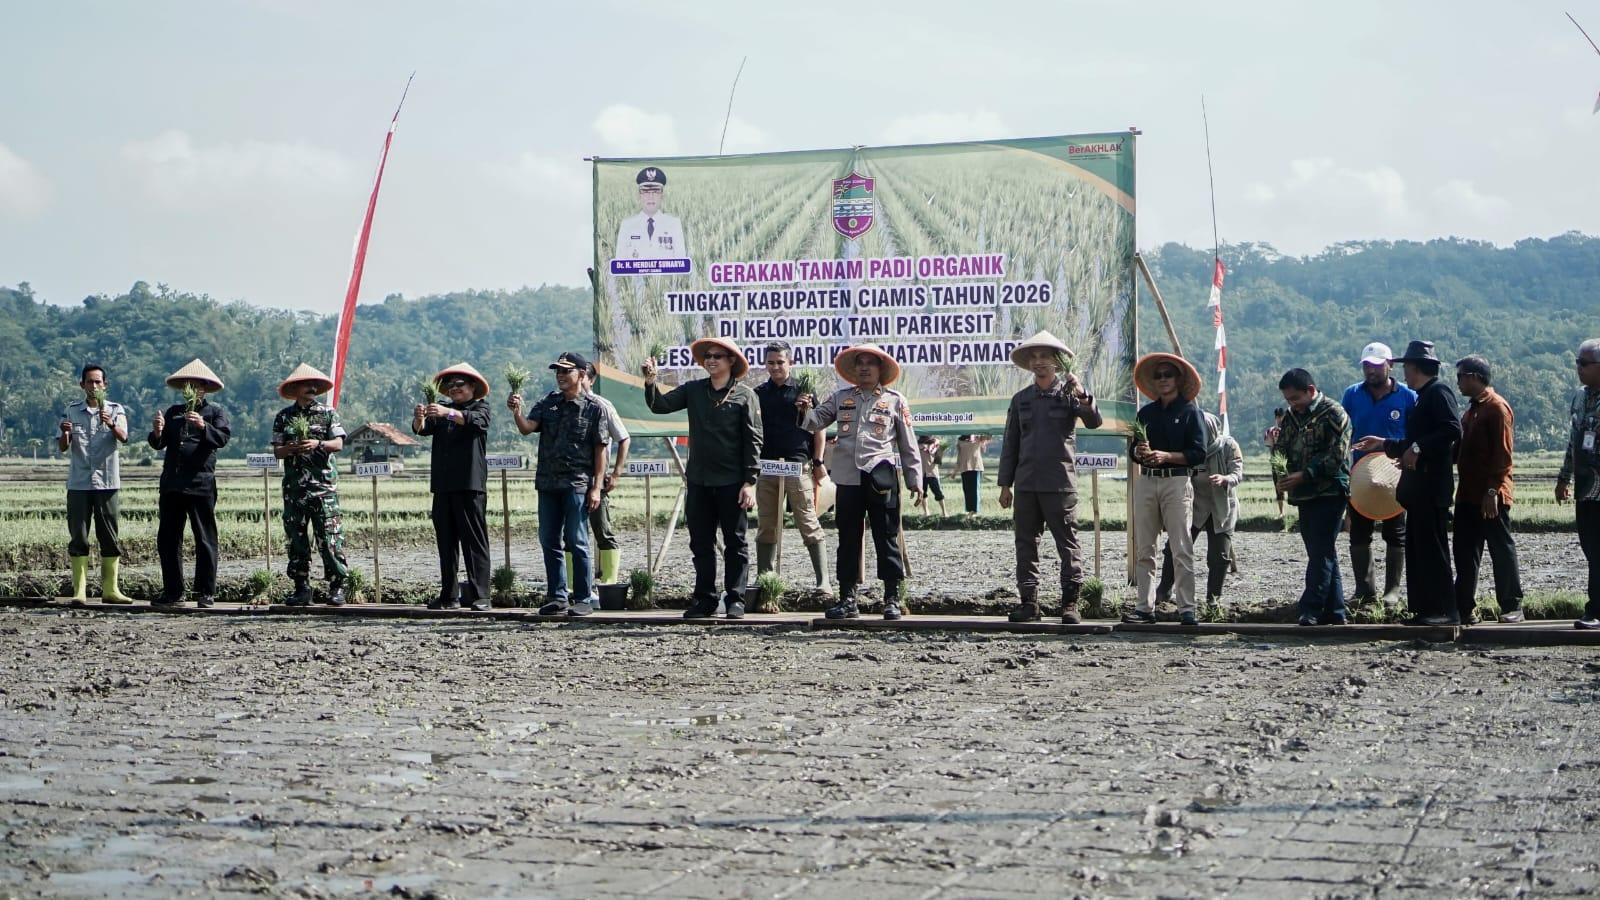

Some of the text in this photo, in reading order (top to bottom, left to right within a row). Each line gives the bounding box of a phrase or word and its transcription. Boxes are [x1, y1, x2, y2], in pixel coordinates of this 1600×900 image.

[711, 255, 1004, 283] GERAKAN TANAM PADI ORGANIK
[668, 284, 1051, 312] TINGKAT KABUPATEN CIAMIS TAHUN 2026
[720, 314, 994, 338] DI KELOMPOK TANI PARIKESIT
[911, 414, 973, 423] .ciamiskab.go.id
[1075, 456, 1113, 466] KAJARI
[630, 463, 664, 473] BUPATI
[761, 462, 790, 471] KEPALA
